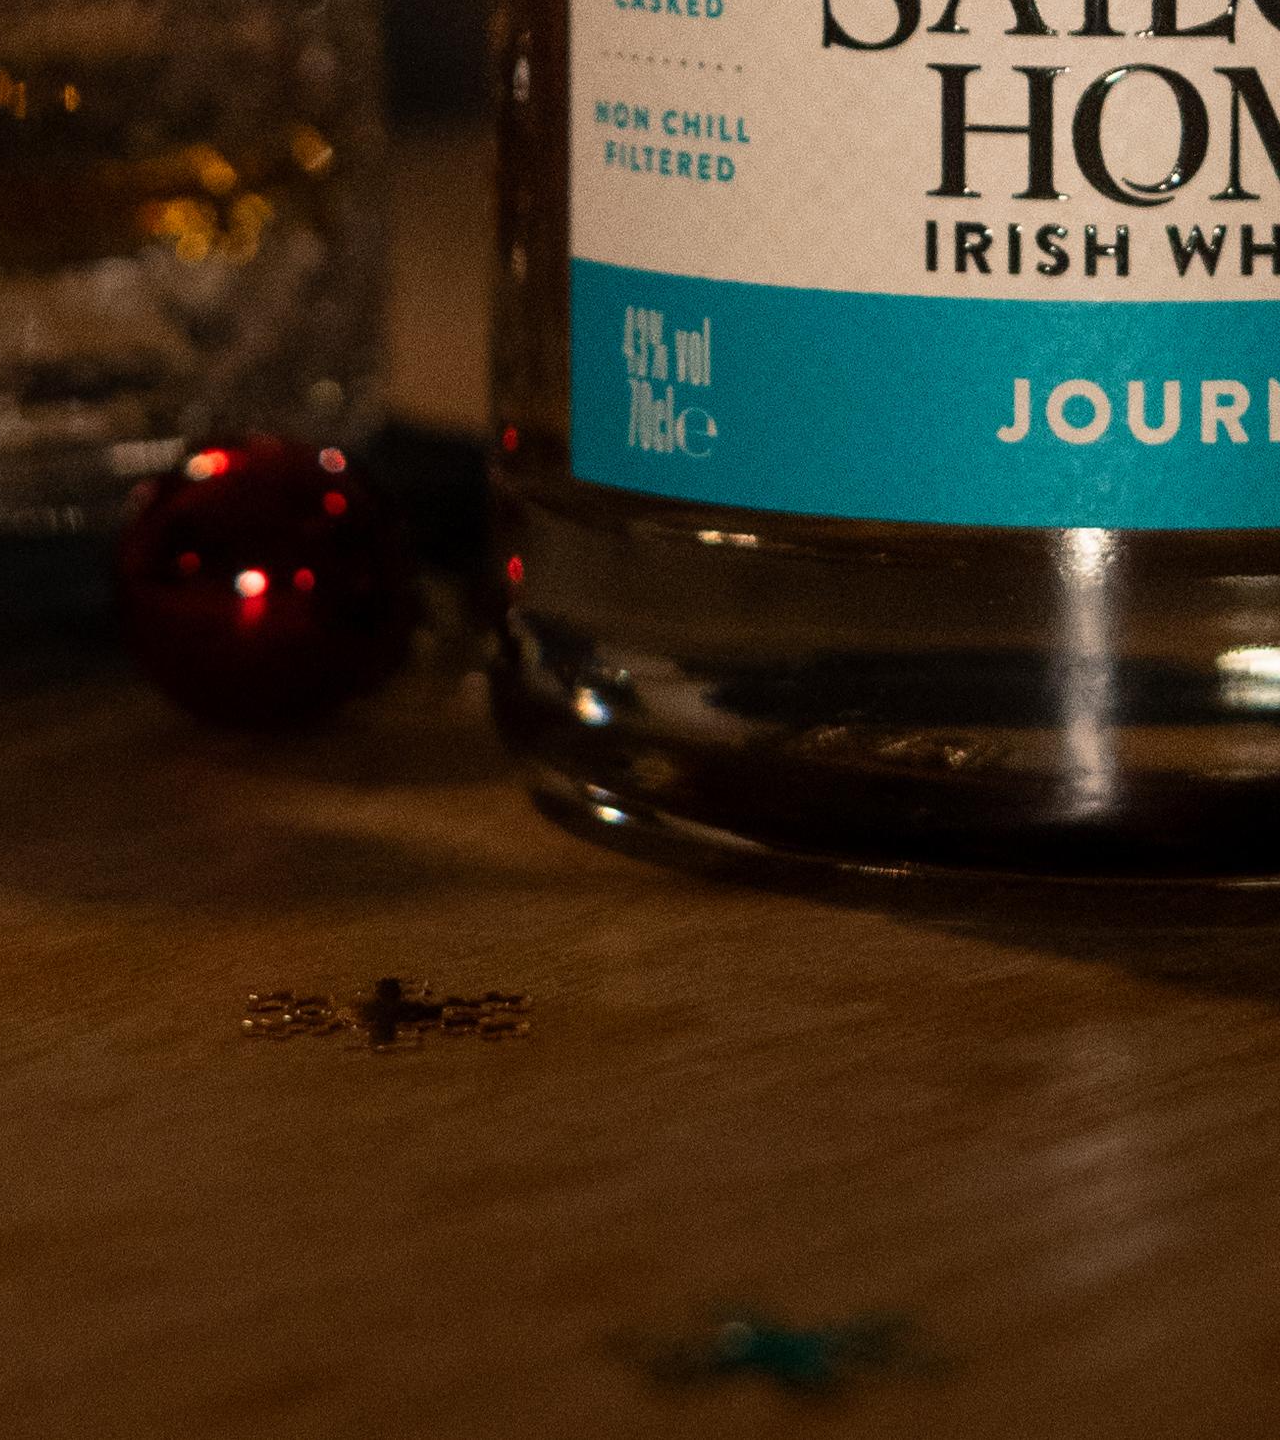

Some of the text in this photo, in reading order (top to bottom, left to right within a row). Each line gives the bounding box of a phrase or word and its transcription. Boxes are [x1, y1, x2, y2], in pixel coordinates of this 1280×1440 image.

[594, 100, 750, 144] NON CHILL
[604, 140, 736, 182] FILTERED
[923, 219, 1131, 277] IRISH
